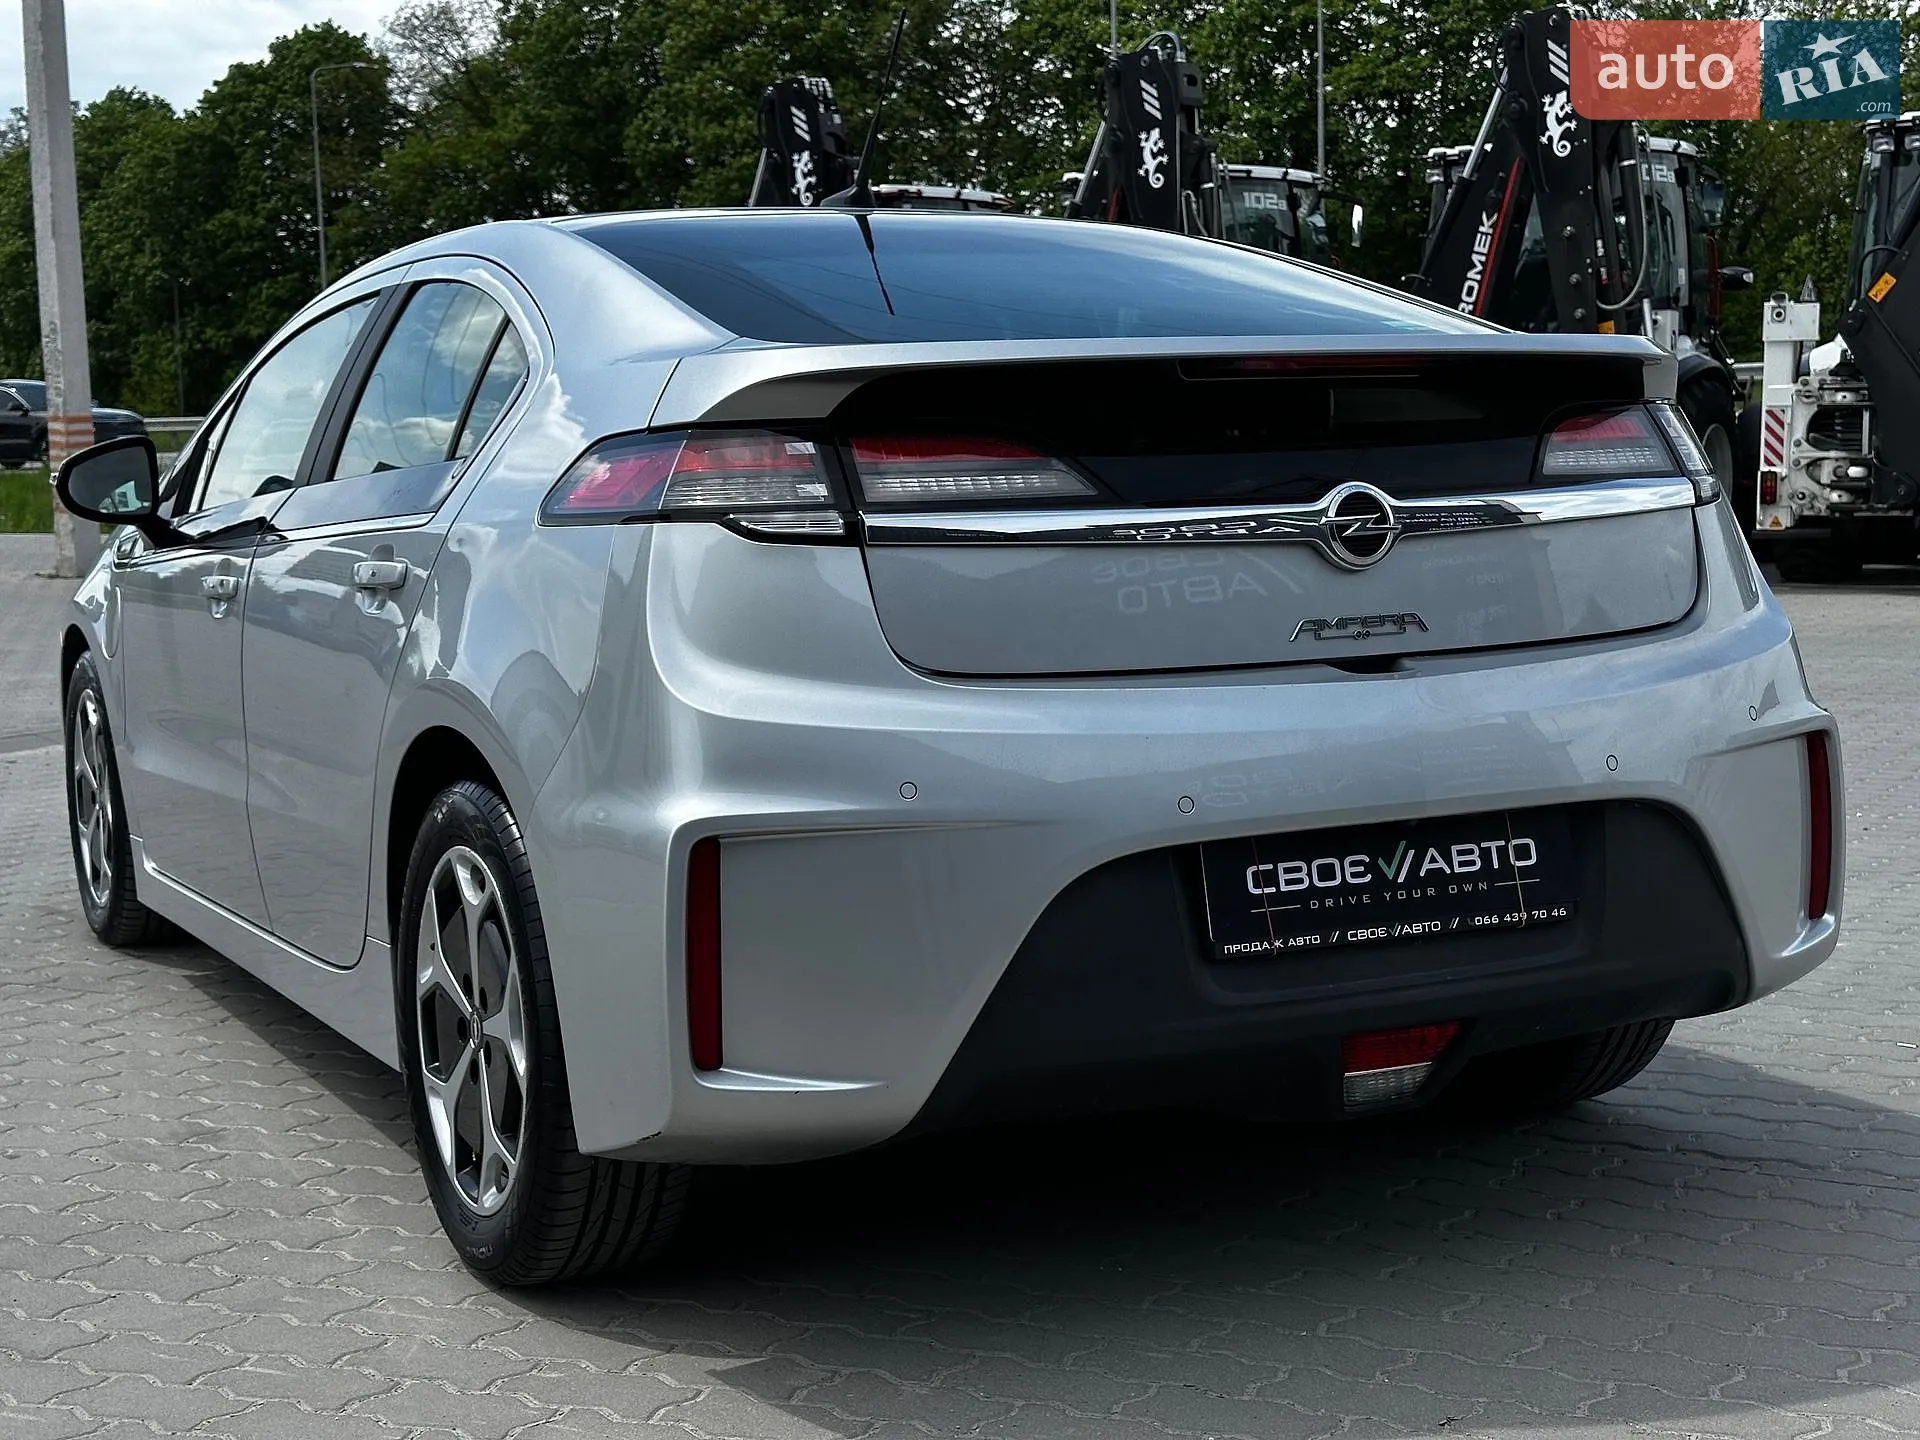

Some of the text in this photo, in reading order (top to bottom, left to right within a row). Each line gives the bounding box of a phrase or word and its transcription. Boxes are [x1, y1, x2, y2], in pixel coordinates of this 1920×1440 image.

[1289, 611, 1430, 642] AMPERA
[1420, 838, 1537, 877] АВТО
[1310, 881, 1488, 909] DRIVE YOUR OWN
[1288, 935, 1320, 947] АВТО
[1474, 914, 1499, 925] 066
[1504, 912, 1527, 922] 439
[1532, 910, 1547, 920] 70
[1551, 907, 1566, 917] 46
